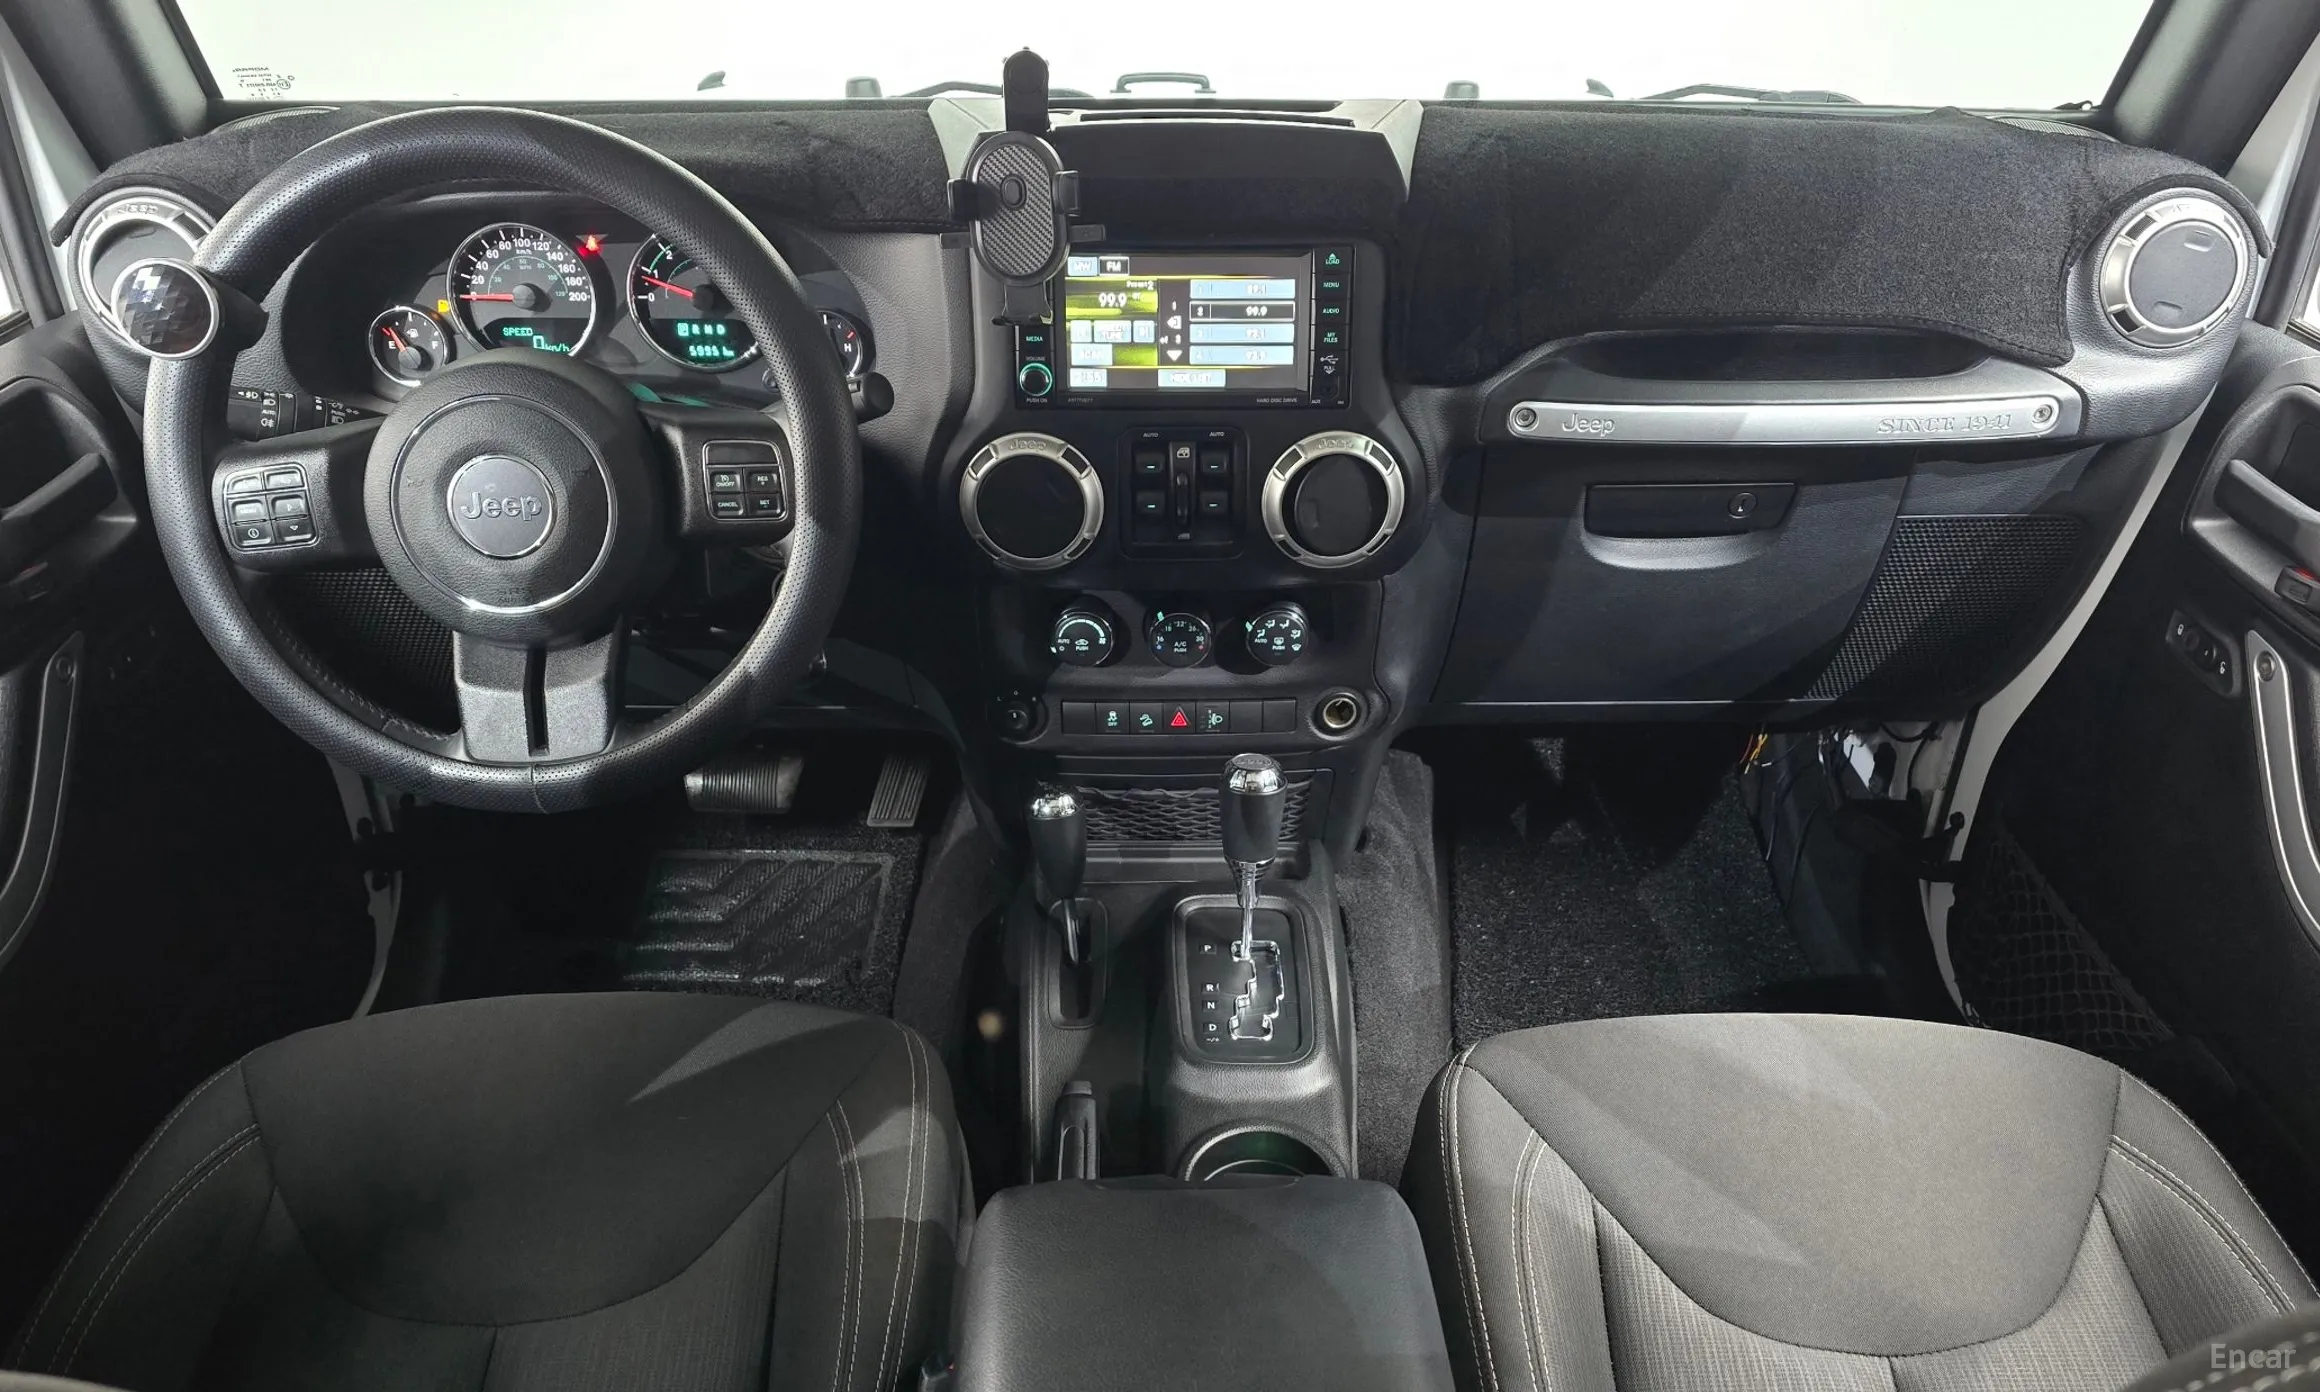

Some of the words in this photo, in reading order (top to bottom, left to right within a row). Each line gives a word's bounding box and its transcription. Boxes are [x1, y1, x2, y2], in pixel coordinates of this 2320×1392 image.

[499, 241, 512, 250] 80
[513, 238, 531, 247] 100
[532, 241, 550, 251] 120
[486, 250, 499, 259] 60
[546, 252, 564, 261] 140
[666, 250, 673, 260] 2
[475, 261, 489, 271] 40
[558, 263, 576, 273] 160
[1106, 261, 1122, 272] FM
[653, 269, 659, 279] 1
[471, 275, 485, 284] 20
[565, 276, 583, 286] 180
[569, 291, 588, 301] 200
[648, 292, 655, 302] 0
[1099, 292, 1127, 307] 99.9
[1246, 306, 1268, 317] 99.9
[503, 327, 534, 336] SPEED
[716, 324, 726, 335] D
[388, 340, 396, 349] E
[431, 340, 439, 349] F
[844, 343, 852, 352] H
[1562, 412, 1616, 437] Jeep
[1876, 417, 1956, 434] SINCE
[1961, 413, 2013, 432] 1941
[1009, 439, 1047, 452] Jeep
[460, 491, 542, 521] Jeep
[1174, 640, 1187, 648] A/C
[1206, 984, 1214, 992] R
[1207, 1001, 1216, 1009] N
[1208, 1023, 1217, 1031] D
